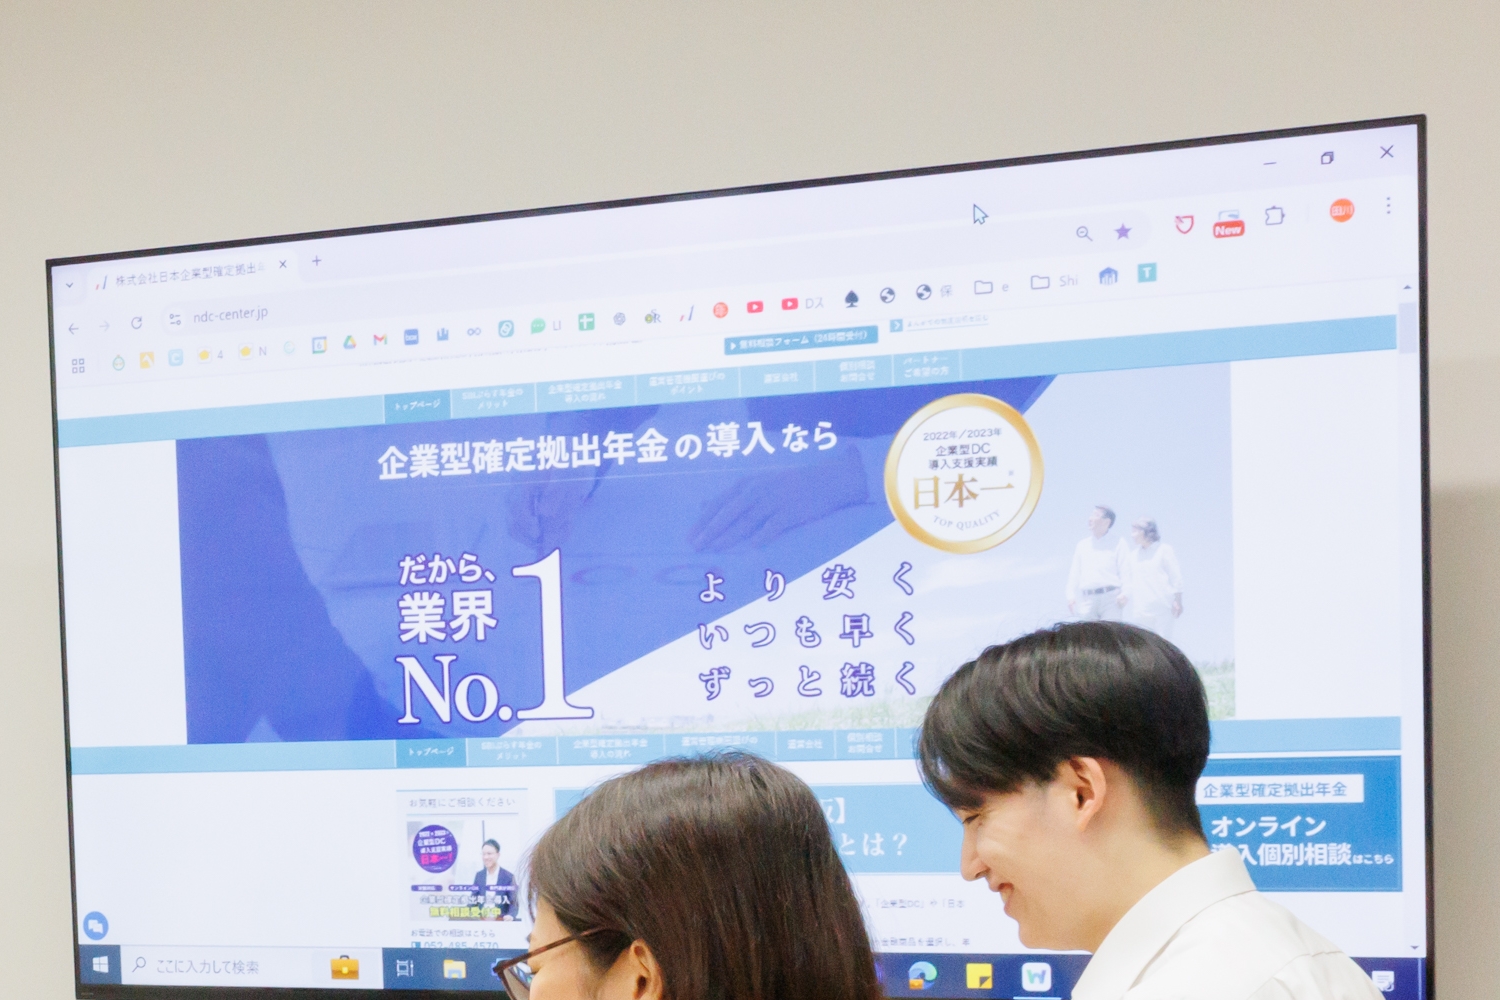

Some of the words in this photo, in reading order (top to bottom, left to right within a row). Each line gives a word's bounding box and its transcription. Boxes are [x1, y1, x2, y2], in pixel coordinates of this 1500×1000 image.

[1215, 224, 1242, 237] New
[193, 307, 268, 323] ndc-center.jp
[377, 419, 838, 481] 企業型確定拠出年金の導入なら
[935, 443, 990, 457] 企業型DC
[913, 473, 1015, 510] 日本一
[933, 515, 953, 529] TOP
[956, 510, 1000, 531] QUALITY
[398, 589, 497, 644] 業界
[698, 611, 917, 651] いつも早く
[699, 659, 918, 701] ずっと続く
[1203, 781, 1348, 798] 企業型確定拠出年金
[1211, 815, 1327, 838] オンライン
[156, 959, 259, 975] ここに入力して検索
